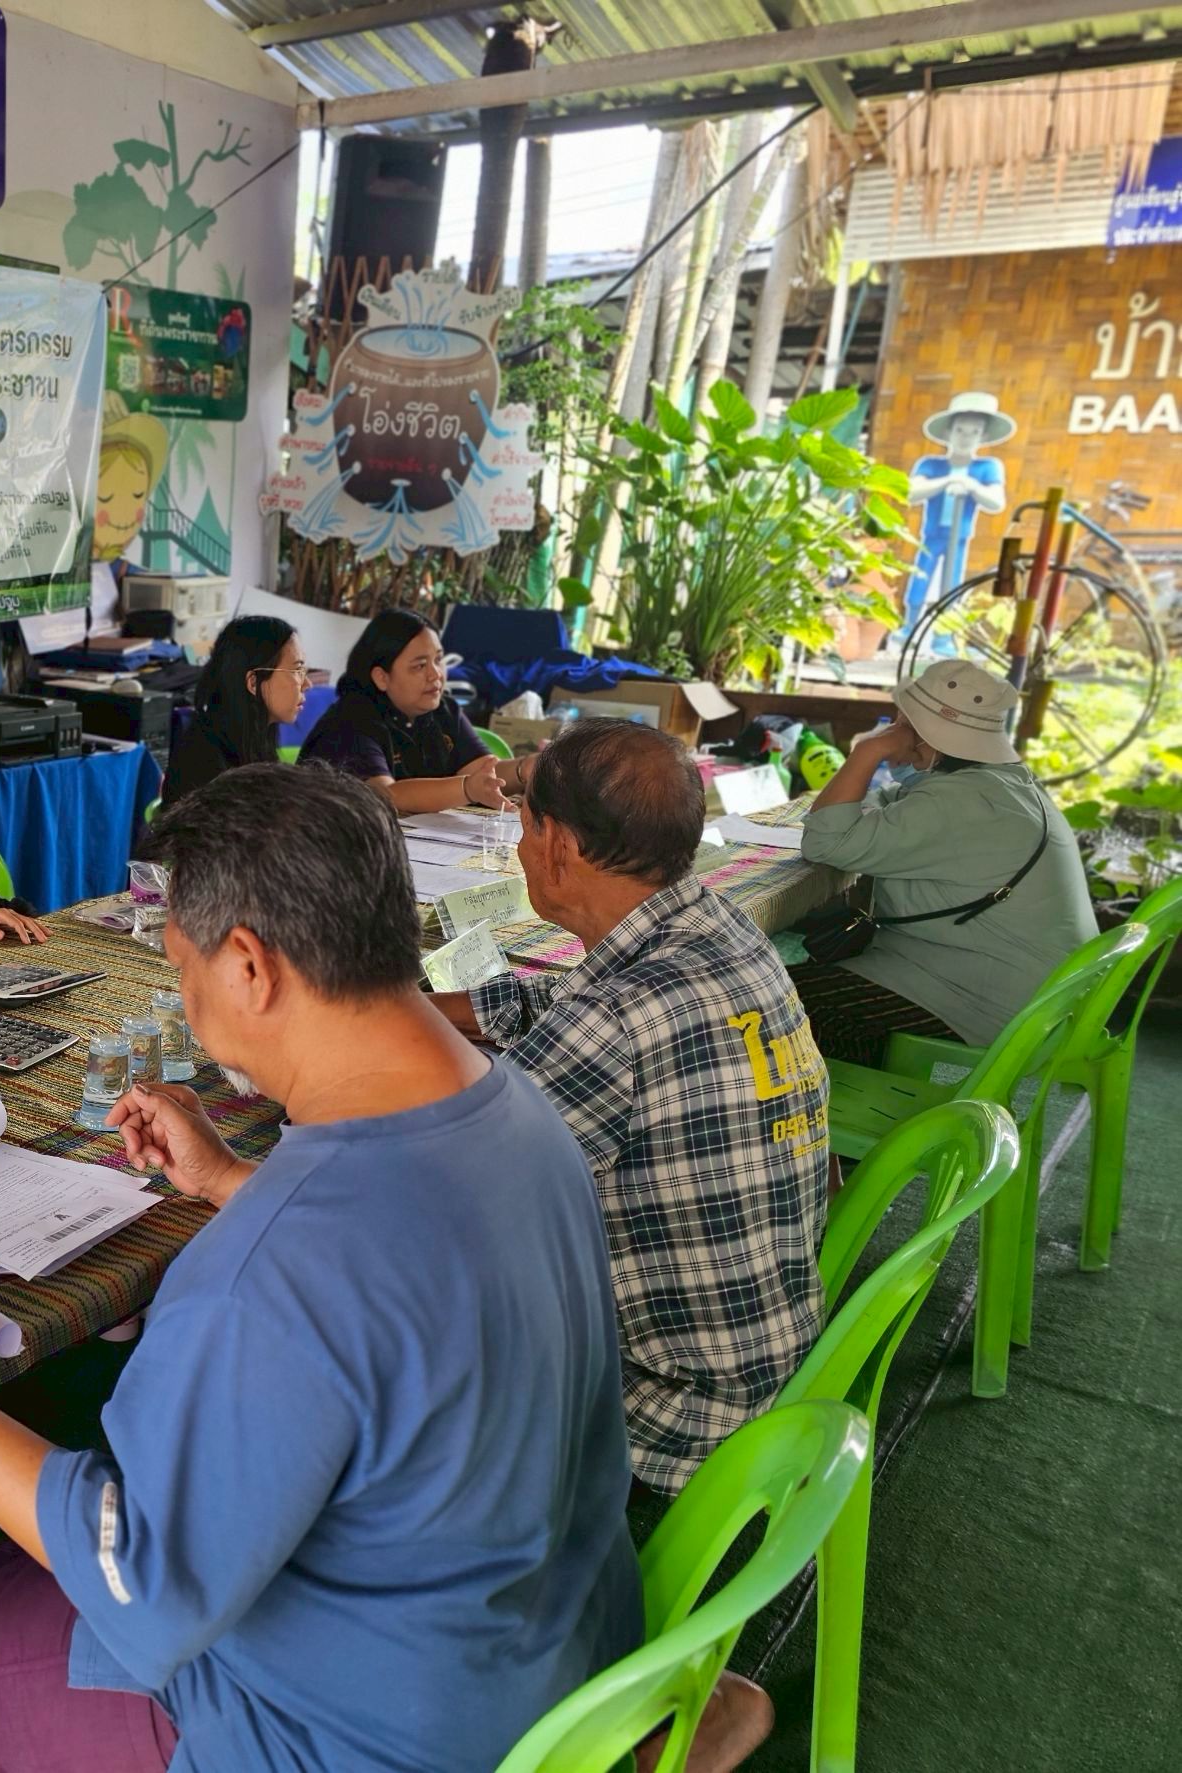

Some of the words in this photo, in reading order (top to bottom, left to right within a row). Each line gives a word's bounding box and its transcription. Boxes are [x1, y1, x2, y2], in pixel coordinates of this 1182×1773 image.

[1090, 291, 1182, 380] บ้า
[359, 386, 461, 440] โอ่งชีวิต
